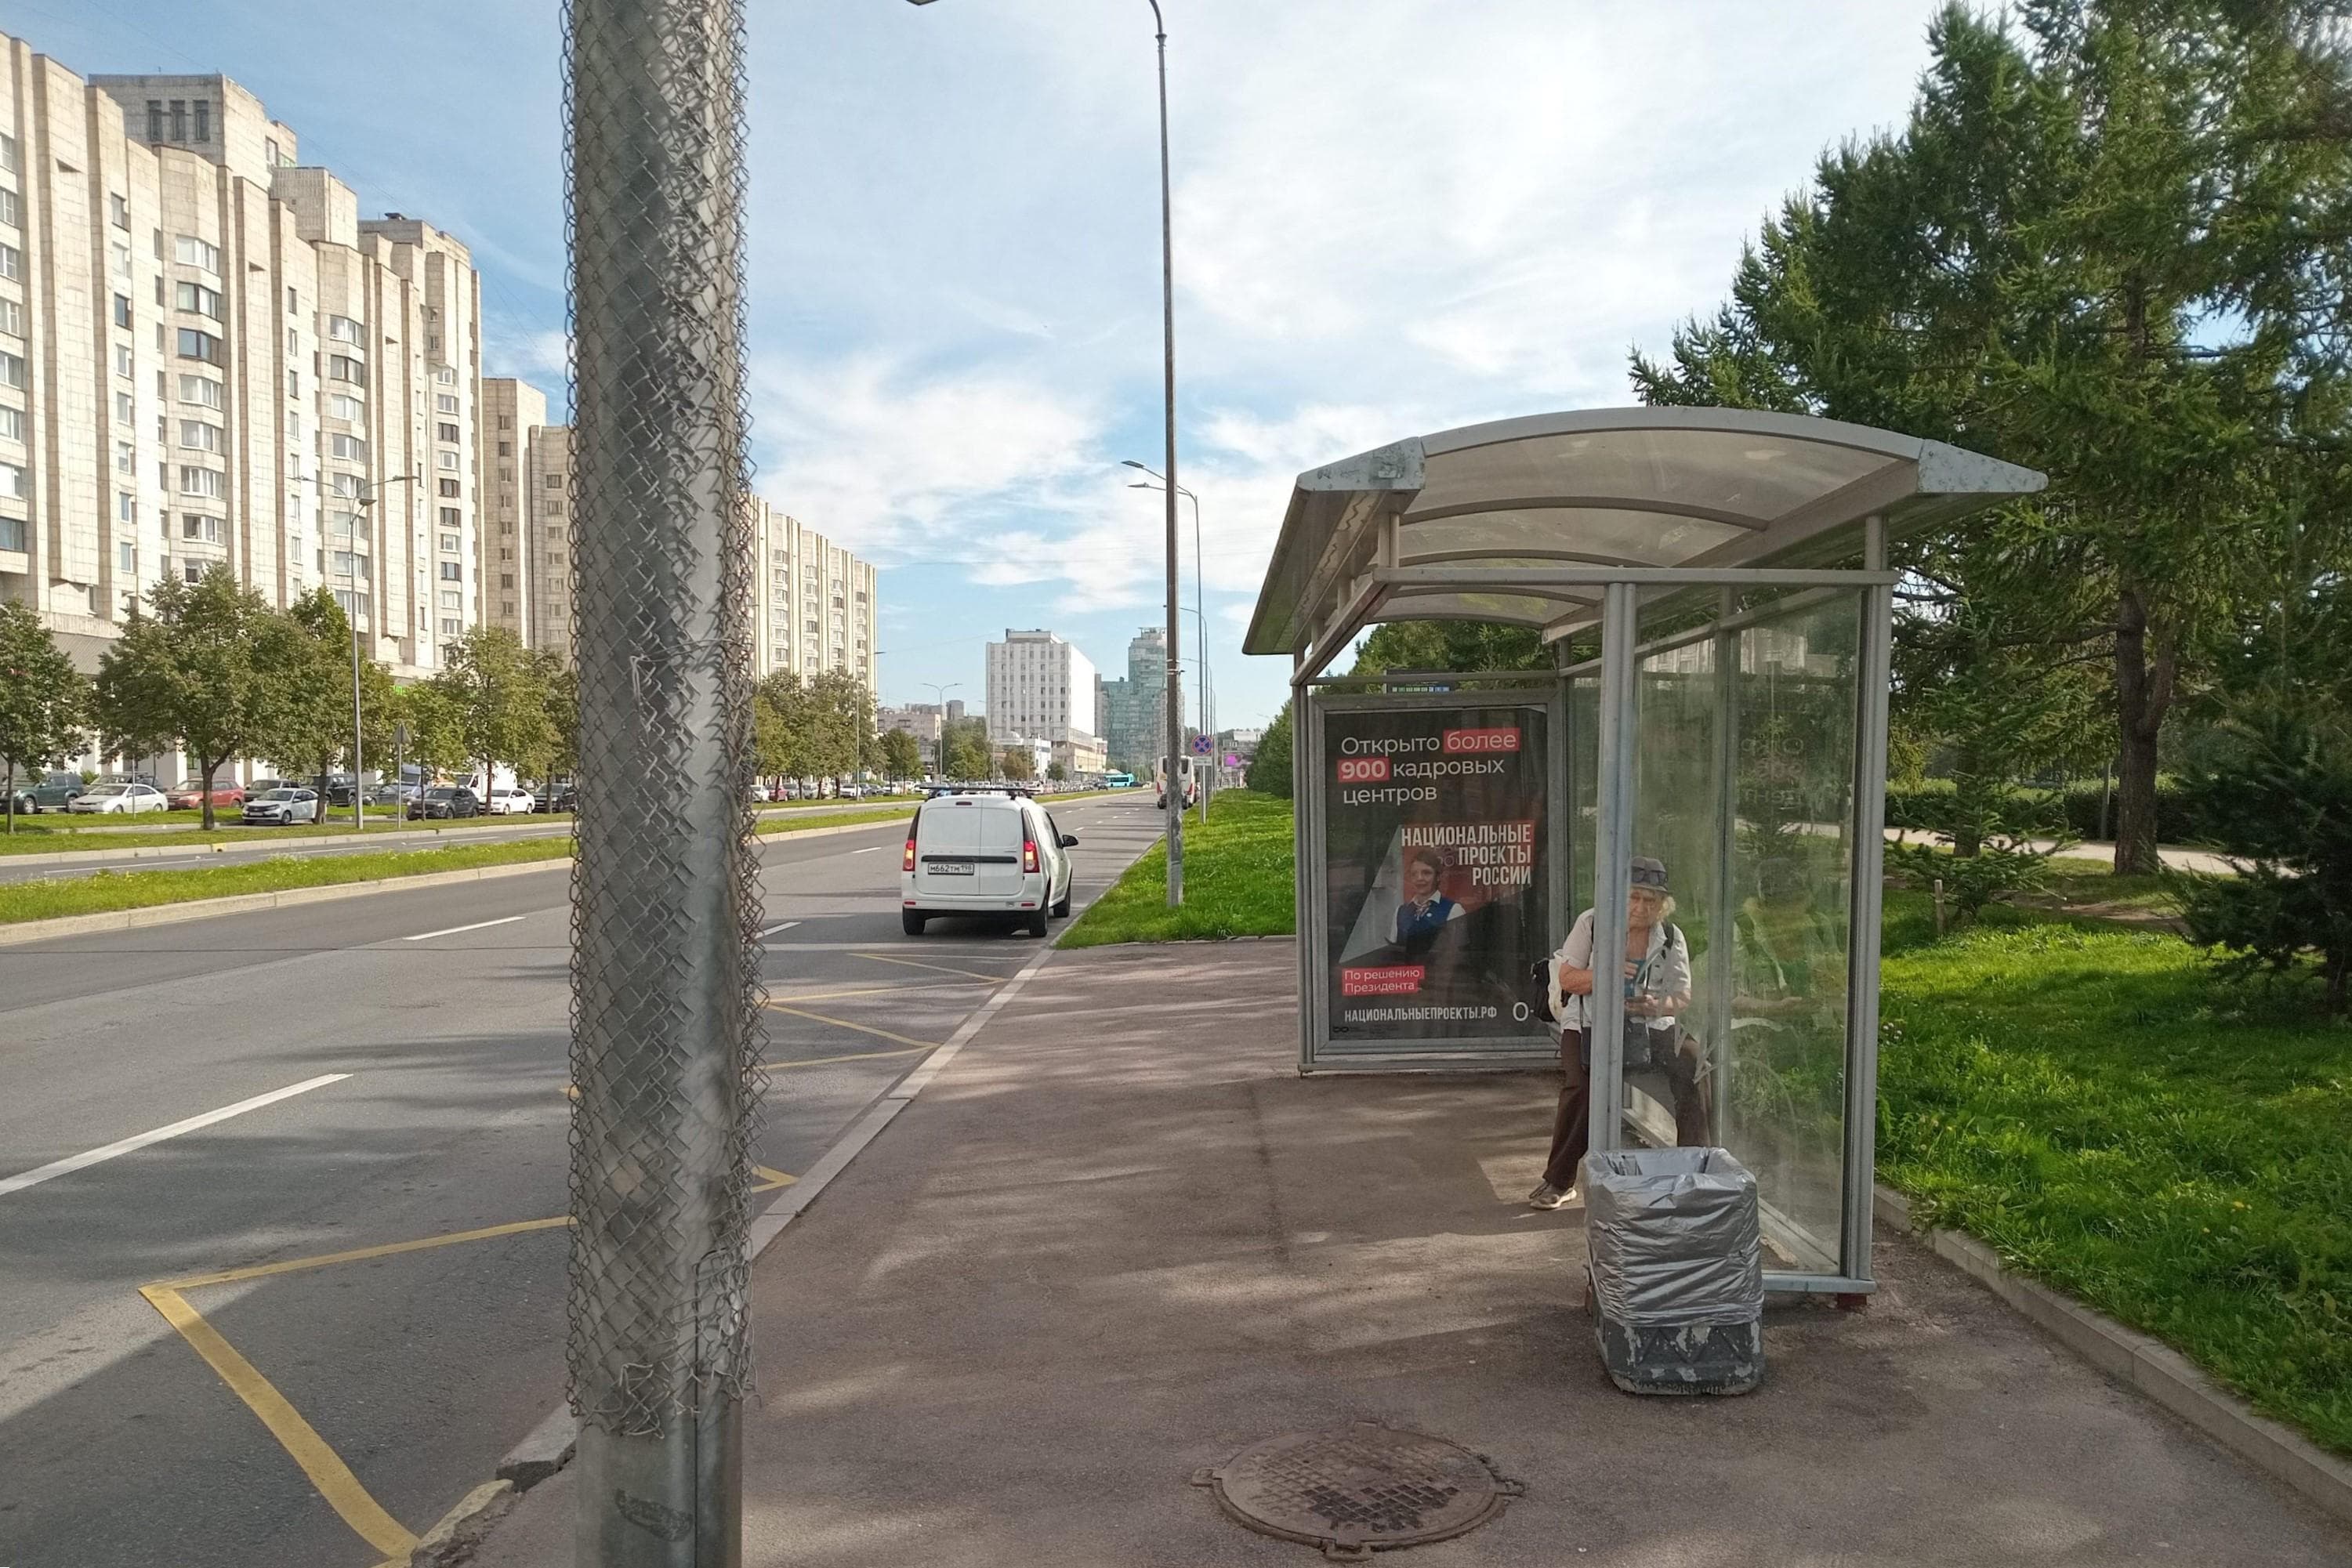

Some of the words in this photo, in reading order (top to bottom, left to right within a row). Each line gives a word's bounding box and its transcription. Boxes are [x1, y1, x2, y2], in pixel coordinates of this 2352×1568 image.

[1341, 737, 1440, 756] Открыто
[1447, 730, 1517, 750] более
[1341, 759, 1386, 780] 900
[1393, 759, 1505, 780] кадровых
[1343, 786, 1437, 806] центров
[1401, 824, 1531, 848] НАЦИОНАЛЬНЫЕ
[1459, 845, 1531, 865] ПРОЕКТЫ
[1473, 866, 1531, 885] РОССИИ
[1345, 970, 1361, 980] По
[1364, 969, 1419, 982] решению
[1345, 982, 1415, 994] Президента
[1344, 1006, 1498, 1023] НАЦИОНАЛЬНЫЕПРОЕКТЫ.РФ
